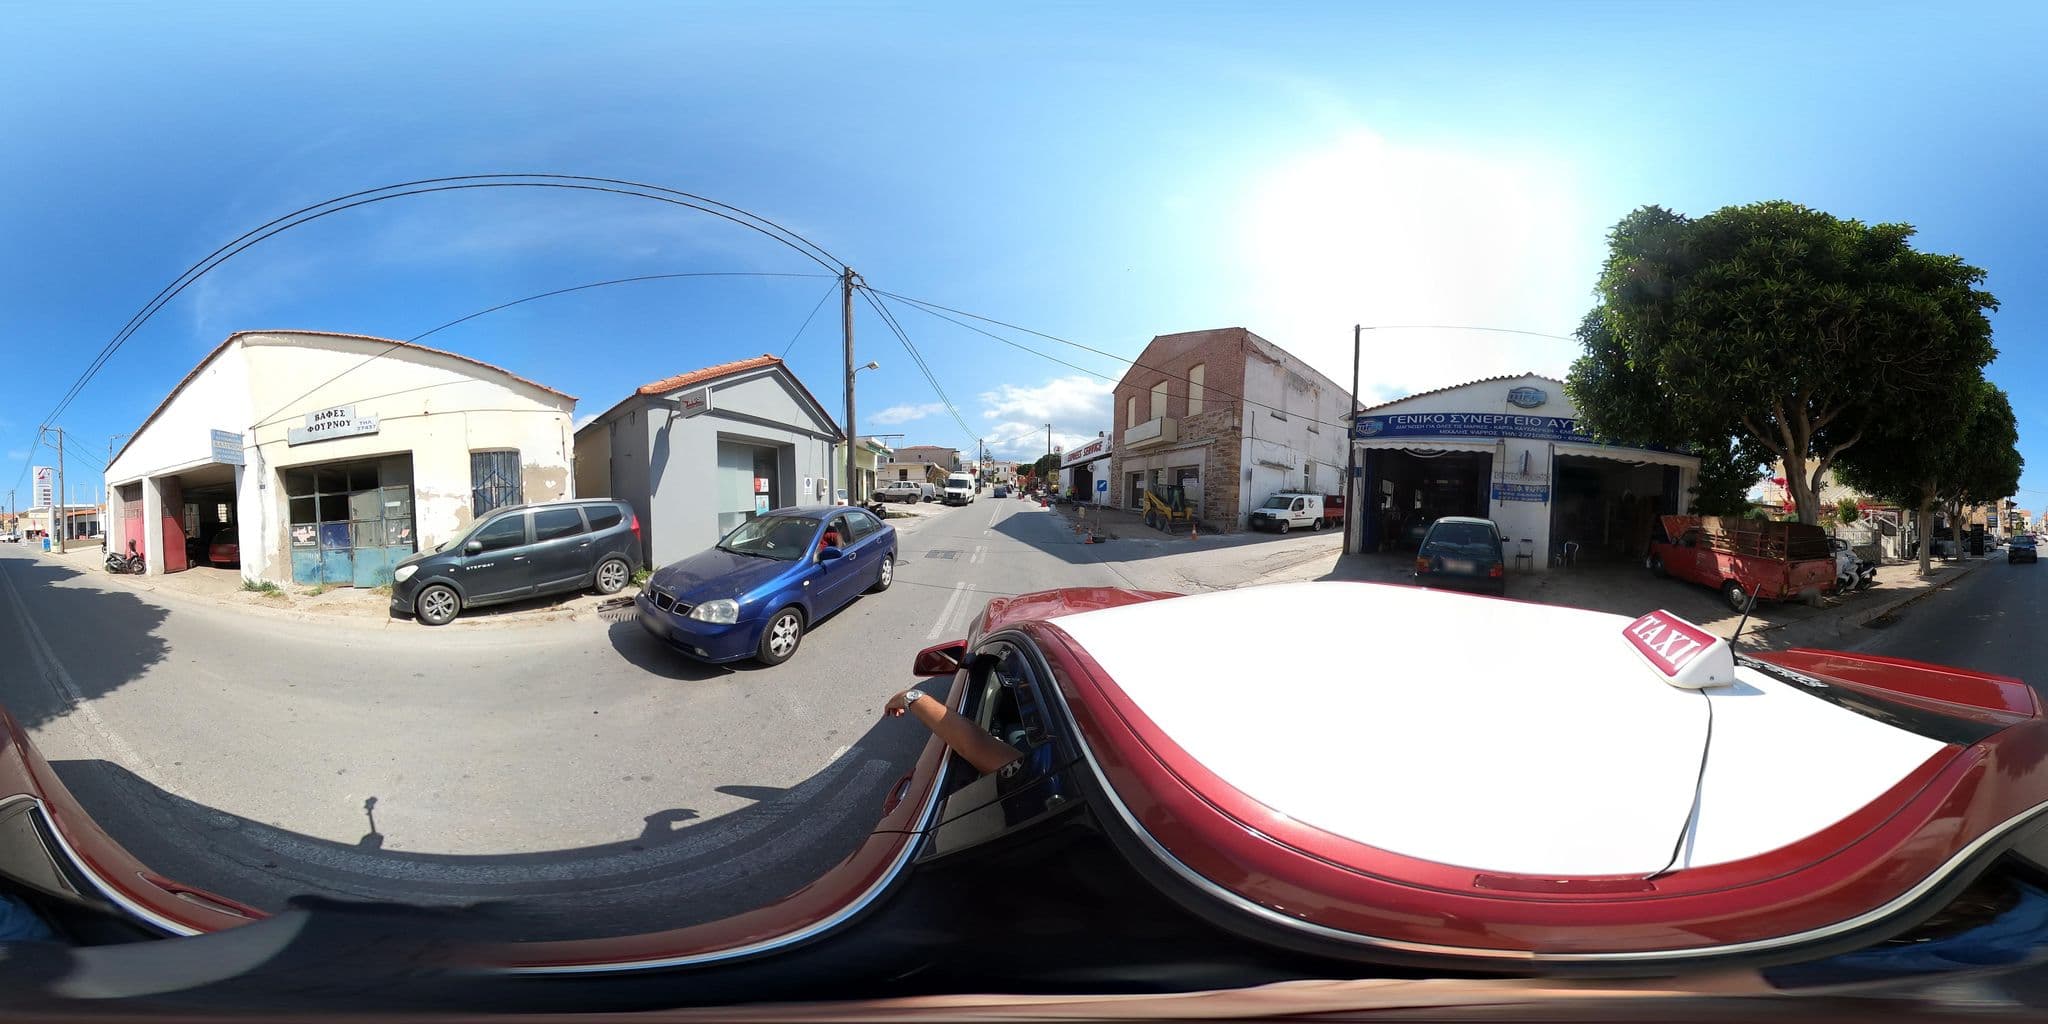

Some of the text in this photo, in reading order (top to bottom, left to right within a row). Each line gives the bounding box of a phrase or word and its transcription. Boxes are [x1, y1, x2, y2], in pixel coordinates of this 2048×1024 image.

[314, 409, 346, 422] ΒΑΦΕΣ
[1388, 414, 1445, 424] ΓΕΝΙΚΟ
[1450, 414, 1542, 427] ΣΥΝΕΡΓΕΙΟ
[307, 420, 352, 433] ΦΟΥΡΝΟΥ
[465, 562, 495, 571] STEPWAY
[1631, 615, 1702, 665] TAXI
